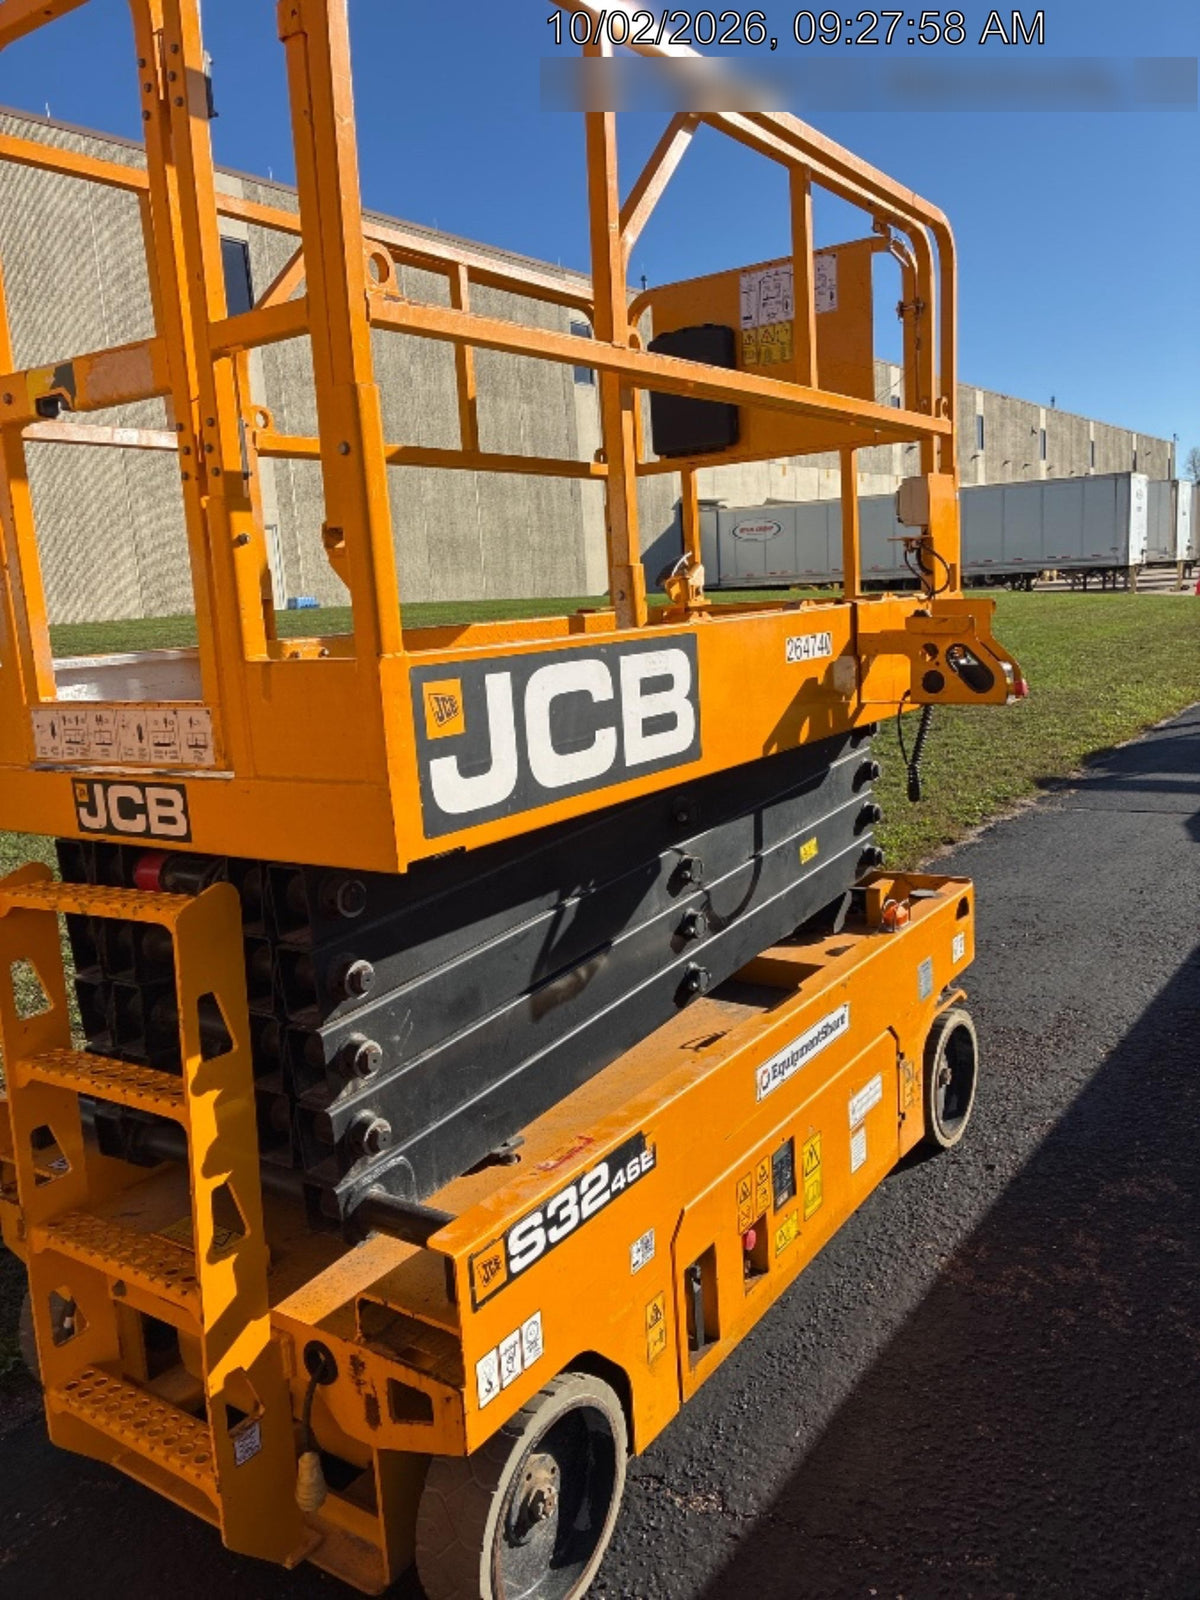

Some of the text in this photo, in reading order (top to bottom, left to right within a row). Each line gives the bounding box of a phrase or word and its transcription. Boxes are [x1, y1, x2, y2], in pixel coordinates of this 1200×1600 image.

[429, 648, 696, 814] JCB
[78, 783, 188, 836] JCB
[771, 1012, 846, 1081] EquipmentShare
